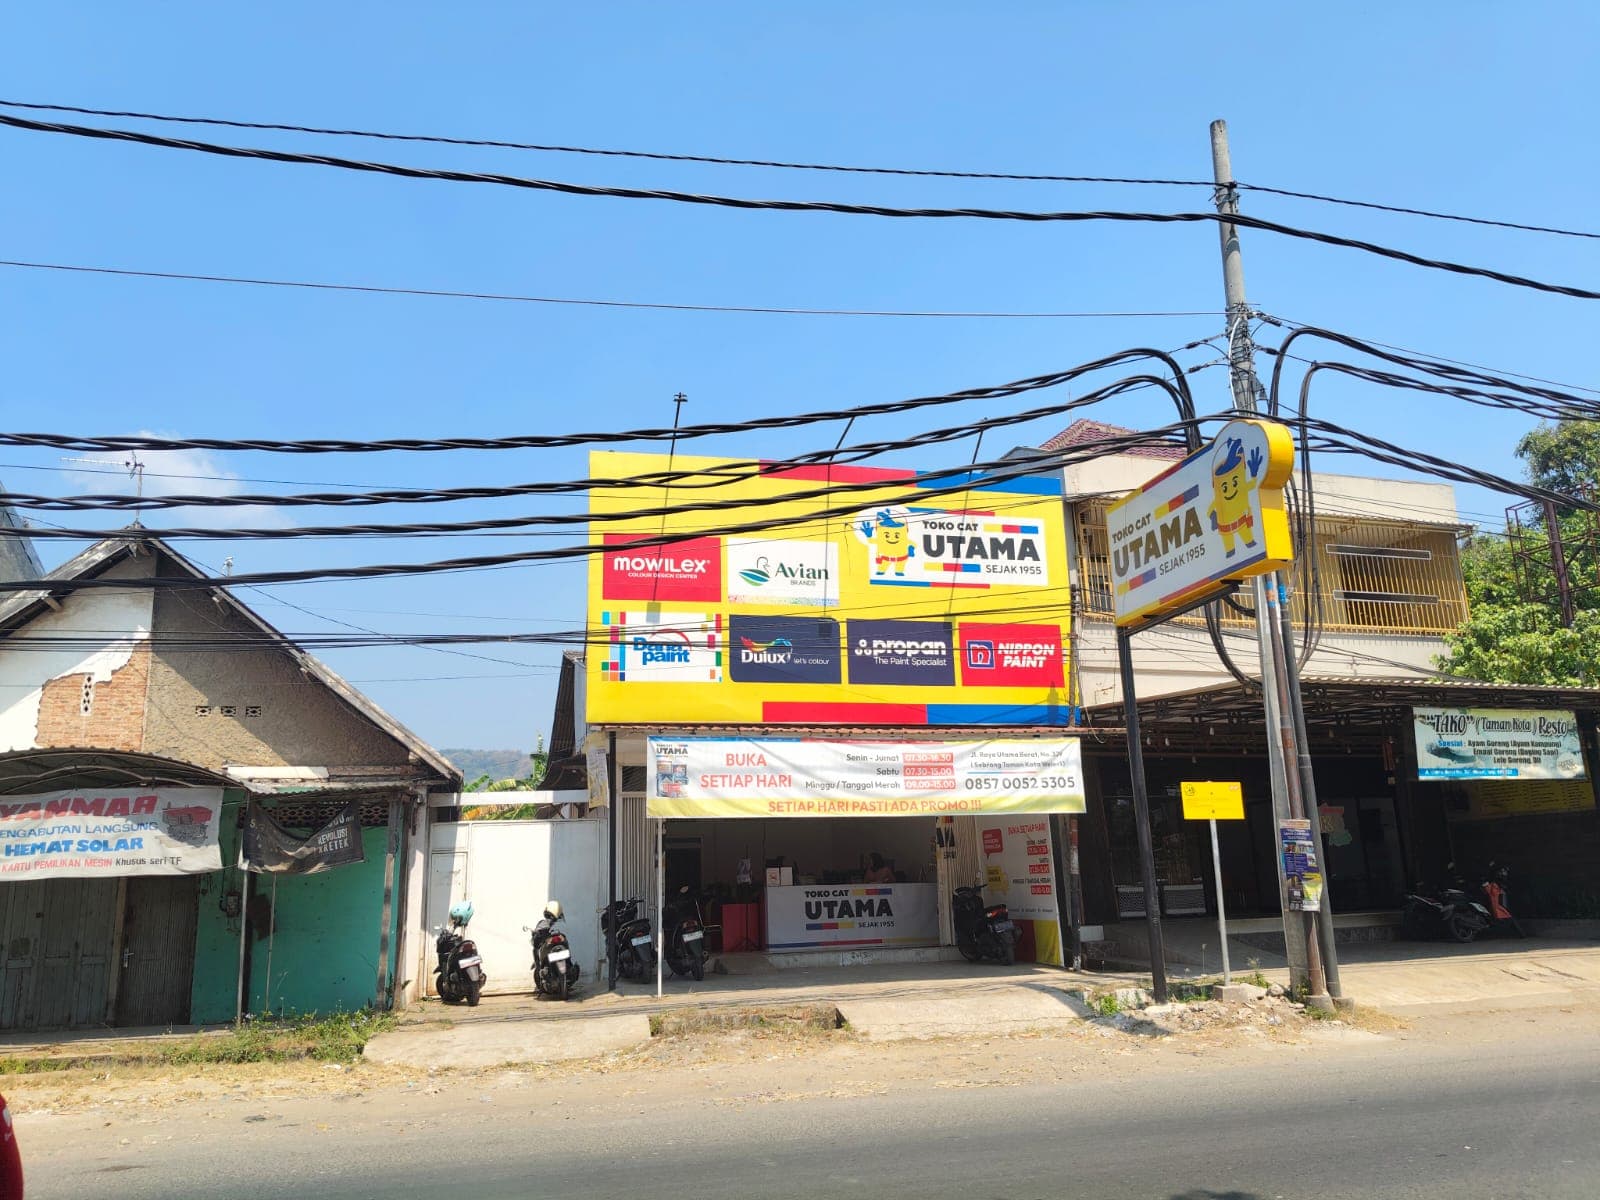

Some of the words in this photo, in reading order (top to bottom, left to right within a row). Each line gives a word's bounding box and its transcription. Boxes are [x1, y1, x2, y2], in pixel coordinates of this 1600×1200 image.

[920, 519, 954, 532] TOKO
[956, 522, 978, 532] CAT
[1112, 523, 1134, 544] TOKO
[1135, 512, 1152, 531] CAT
[922, 534, 1041, 562] UTAMA
[1114, 506, 1204, 578] UTAMA
[1159, 554, 1185, 576] SEJAK
[1185, 543, 1206, 563] 1955
[775, 562, 829, 580] Avian
[985, 564, 1018, 574] SEJAK
[1019, 565, 1042, 576] 1955
[872, 639, 946, 657] propan
[998, 642, 1055, 656] NIPPON
[642, 649, 690, 666] paint
[874, 656, 888, 665] The
[890, 657, 910, 666] Paint
[911, 657, 947, 667] Specialist
[1003, 656, 1046, 668] PAINT
[1482, 716, 1511, 732] Taman
[1538, 716, 1568, 735] Resto
[726, 753, 768, 767] BUKA
[846, 753, 868, 761] Senin
[874, 754, 899, 762] Jumat
[876, 767, 900, 776] Sabtu
[700, 774, 753, 788] SETIAP
[756, 774, 792, 788] HARI
[805, 780, 836, 791] Minggu
[842, 781, 874, 791] Tanggal
[965, 778, 999, 790] 0857
[1002, 778, 1038, 790] 0052
[1041, 776, 1075, 788] 5305
[0, 795, 158, 822] YANMAR
[768, 800, 814, 812] SETIAP
[817, 800, 848, 812] HARI
[852, 800, 889, 812] PASTI
[890, 800, 918, 812] ADA
[921, 800, 969, 812] PROMO
[86, 822, 159, 834] LANGSUNG
[4, 840, 74, 856] HEMAT
[76, 837, 144, 853] SOLAR
[2, 861, 32, 872] KARTU
[34, 860, 80, 870] PEMILIKAN
[84, 858, 112, 868] MESIN
[115, 857, 146, 867] Khusus
[150, 856, 166, 865] seri
[169, 856, 182, 865] TF
[804, 890, 830, 898] TOKO
[832, 890, 849, 898] CAT
[805, 898, 894, 920] UTAMA
